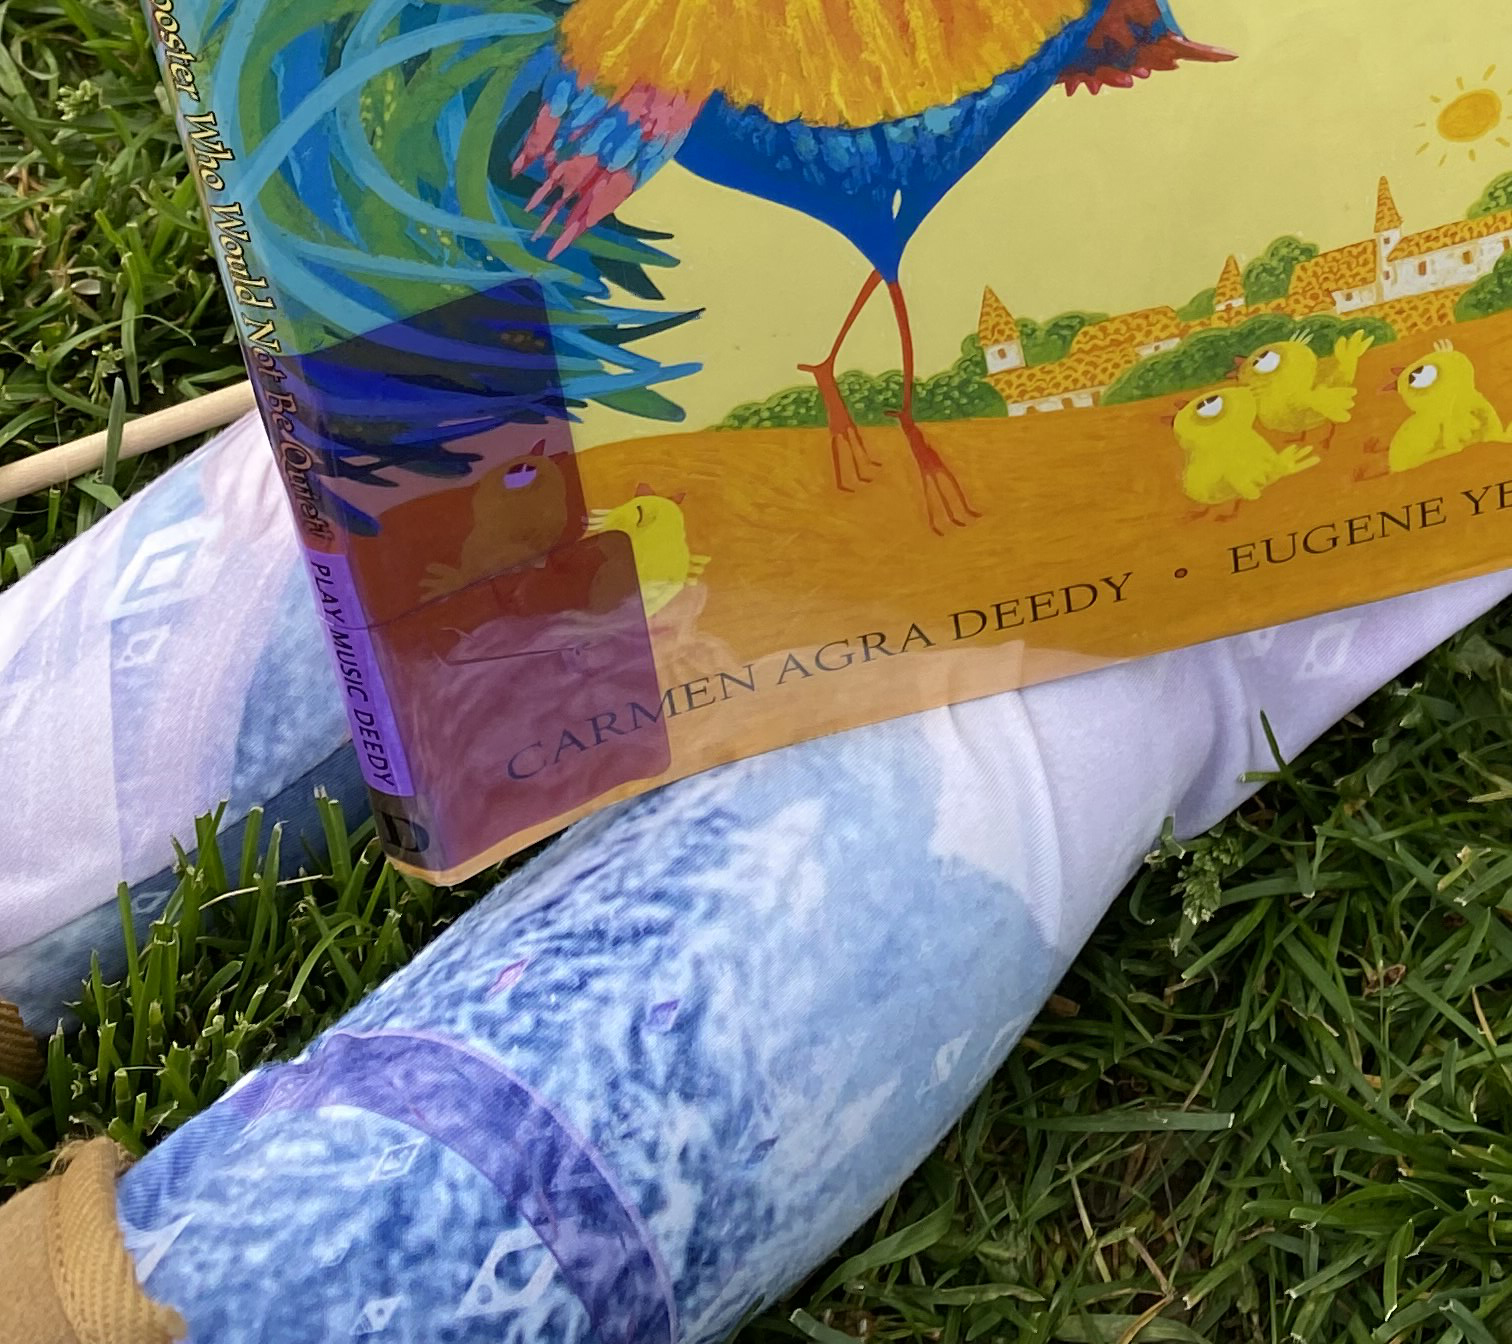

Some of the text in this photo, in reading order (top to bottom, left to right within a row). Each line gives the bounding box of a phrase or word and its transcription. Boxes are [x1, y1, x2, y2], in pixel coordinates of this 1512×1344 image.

[183, 110, 236, 192] Who
[209, 201, 278, 311] Would
[241, 312, 289, 383] Not
[264, 389, 298, 435] Be
[310, 558, 395, 788] PLAY MUSIC DEEDY
[505, 663, 757, 783] CARMEN
[776, 621, 937, 687] AGRA
[948, 571, 1135, 642] DEEDY
[1226, 496, 1449, 575] EUGENE
[379, 812, 431, 855] D
